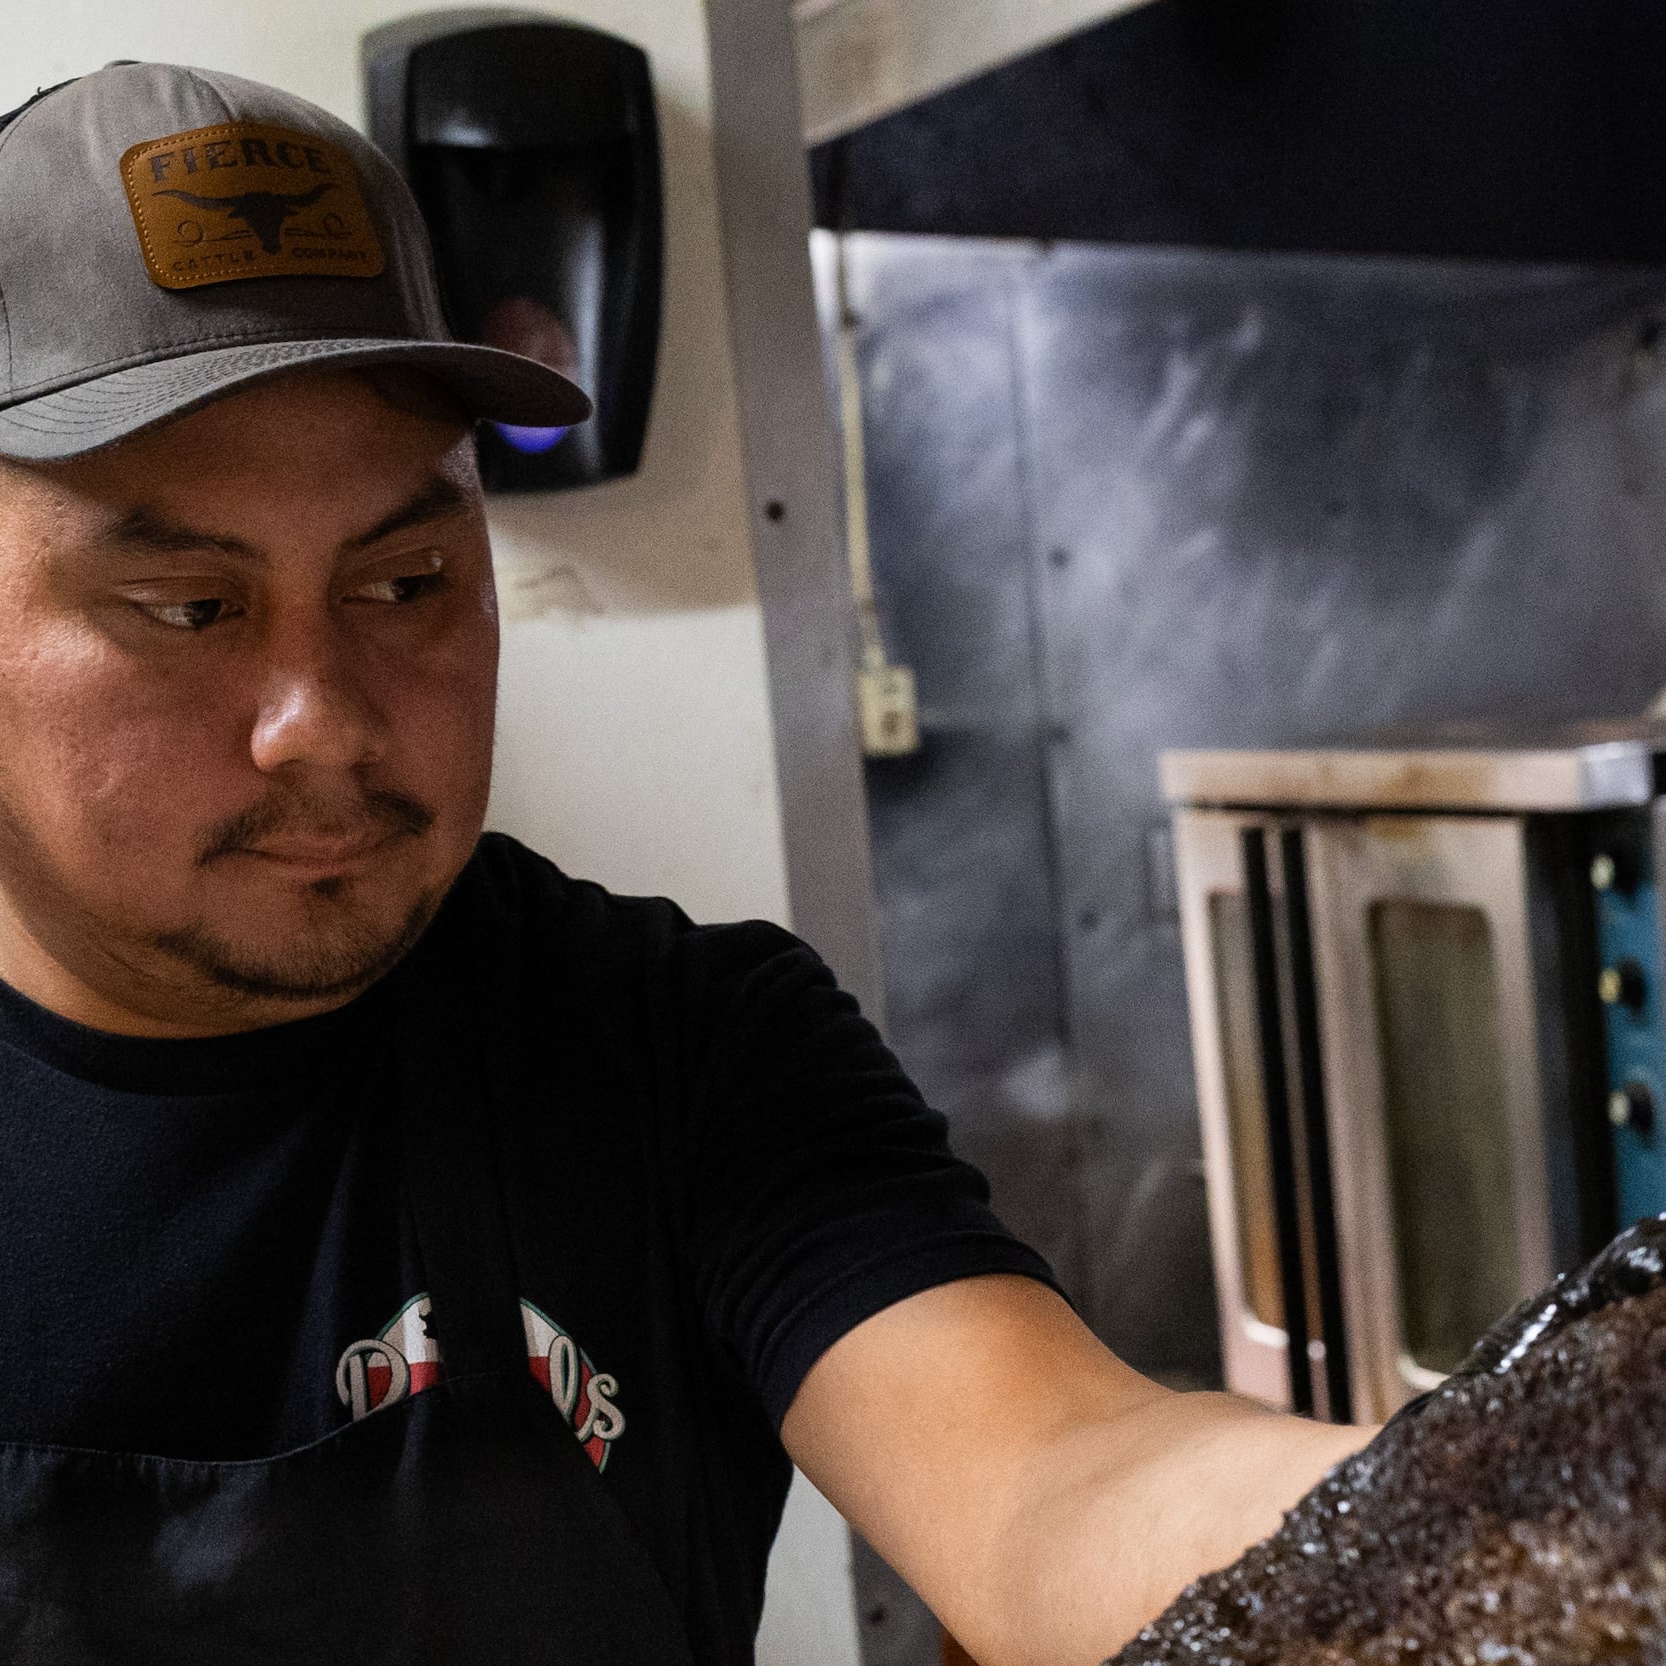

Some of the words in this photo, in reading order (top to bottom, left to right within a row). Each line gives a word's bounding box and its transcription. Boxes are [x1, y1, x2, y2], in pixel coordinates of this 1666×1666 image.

[148, 137, 331, 183] FIERCE
[172, 249, 257, 272] CATTLE
[290, 246, 368, 262] COMPANY
